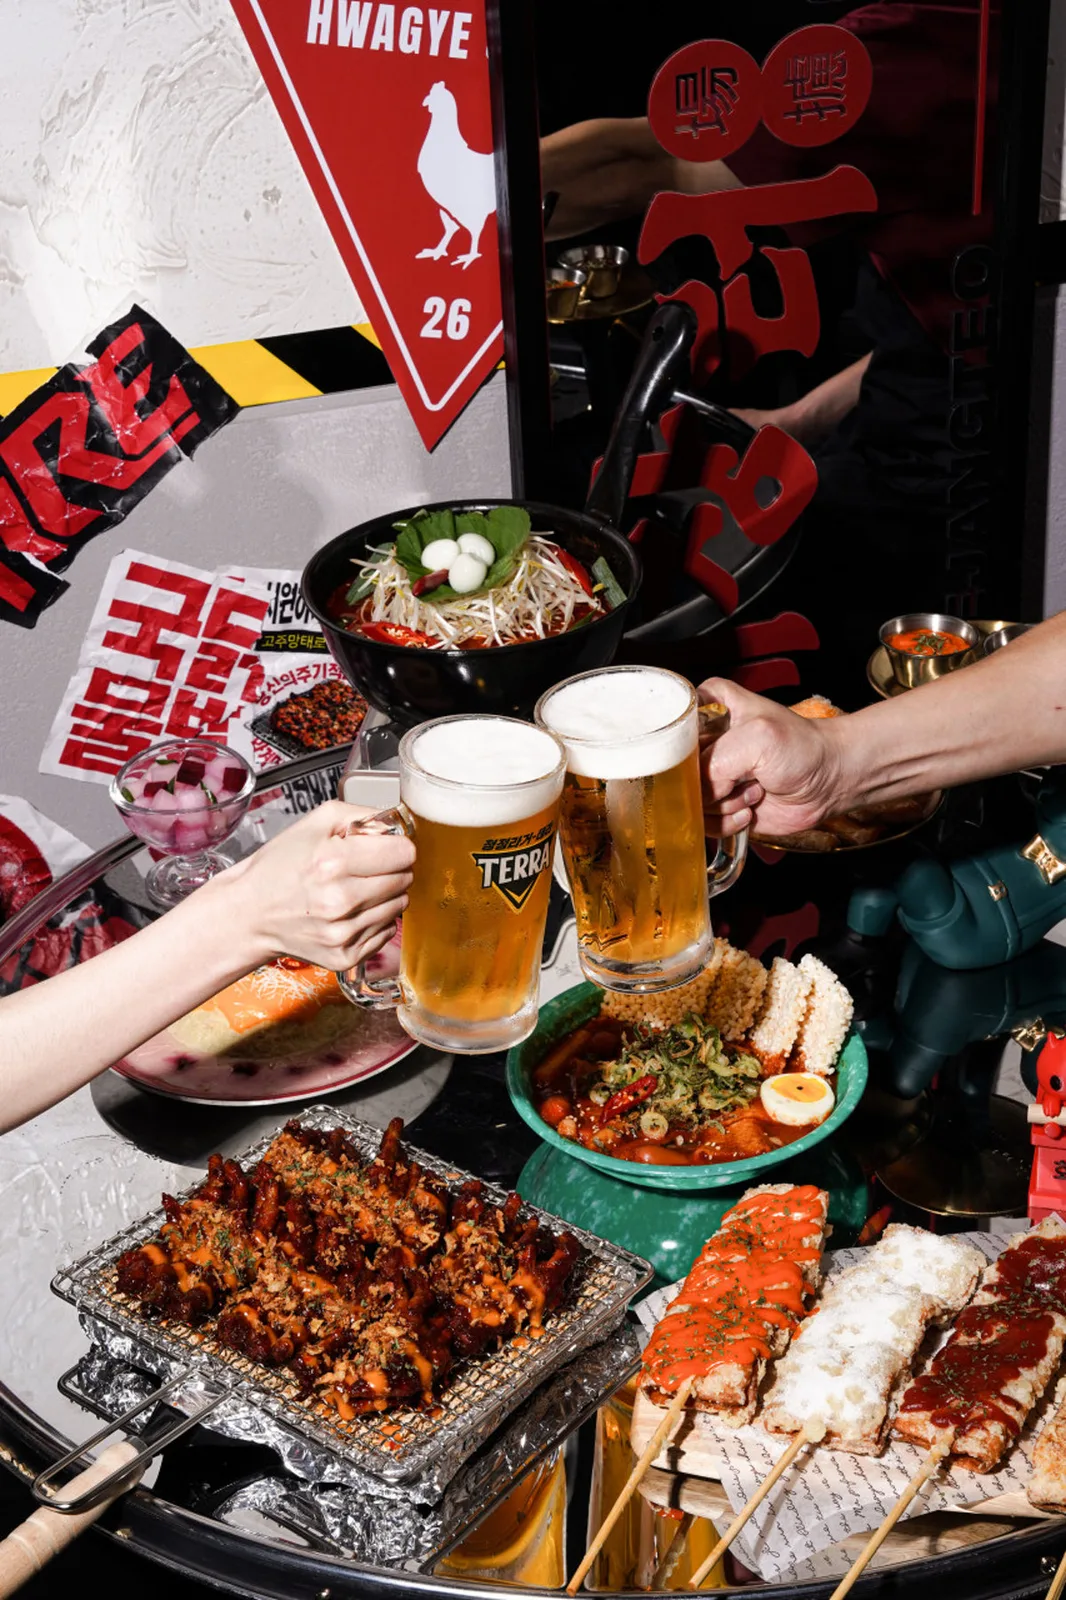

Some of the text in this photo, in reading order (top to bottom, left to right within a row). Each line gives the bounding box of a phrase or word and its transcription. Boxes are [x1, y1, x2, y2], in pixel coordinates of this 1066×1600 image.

[306, 0, 472, 59] HWAGYE
[420, 297, 471, 340] 26
[477, 842, 550, 888] TERRA
